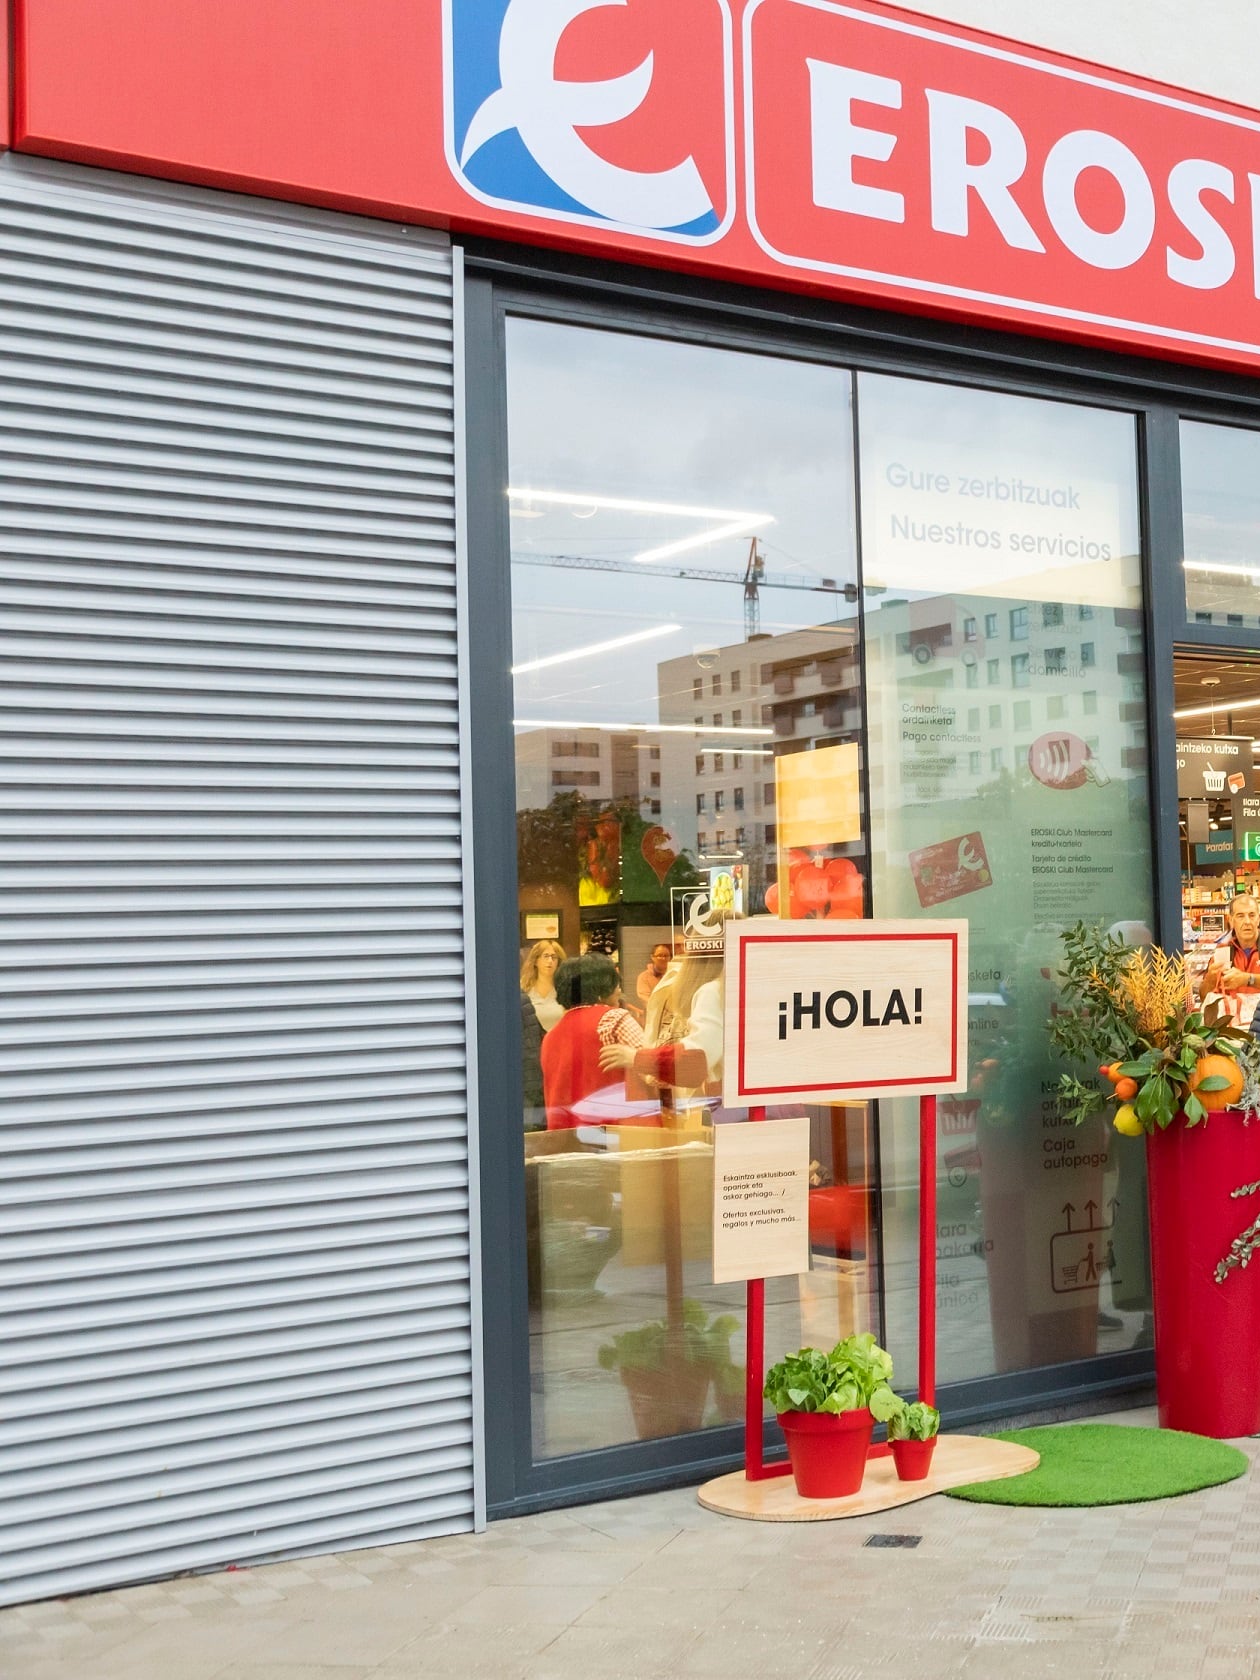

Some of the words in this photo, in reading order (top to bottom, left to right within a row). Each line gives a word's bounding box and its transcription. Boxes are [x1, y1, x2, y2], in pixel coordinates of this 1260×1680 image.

[886, 462, 951, 494] Gure
[957, 475, 1081, 510] zerbitzuak
[891, 513, 1001, 549] Nuestros
[1009, 532, 1112, 562] servicios
[902, 731, 928, 743] Pago
[1176, 743, 1213, 755] aintzeko
[1214, 743, 1239, 755] kutxa
[1243, 807, 1257, 817] Fila
[1030, 828, 1056, 837] EROSKI
[1056, 828, 1073, 837] Club
[1032, 854, 1056, 864] Tarjeta
[1057, 854, 1066, 862] de
[1032, 866, 1057, 874] EROSKI
[1057, 866, 1075, 874] Club
[685, 940, 723, 950] EROSKI
[778, 987, 923, 1041] ¡HOLA!
[1042, 1138, 1075, 1154] Caja
[1043, 1152, 1109, 1170] autopago
[723, 1174, 755, 1182] Eskaintza
[723, 1183, 750, 1192] opariak
[723, 1192, 743, 1201] askoz
[722, 1210, 748, 1219] Ofertas
[722, 1219, 748, 1229] regalos
[755, 1216, 780, 1225] mucho
